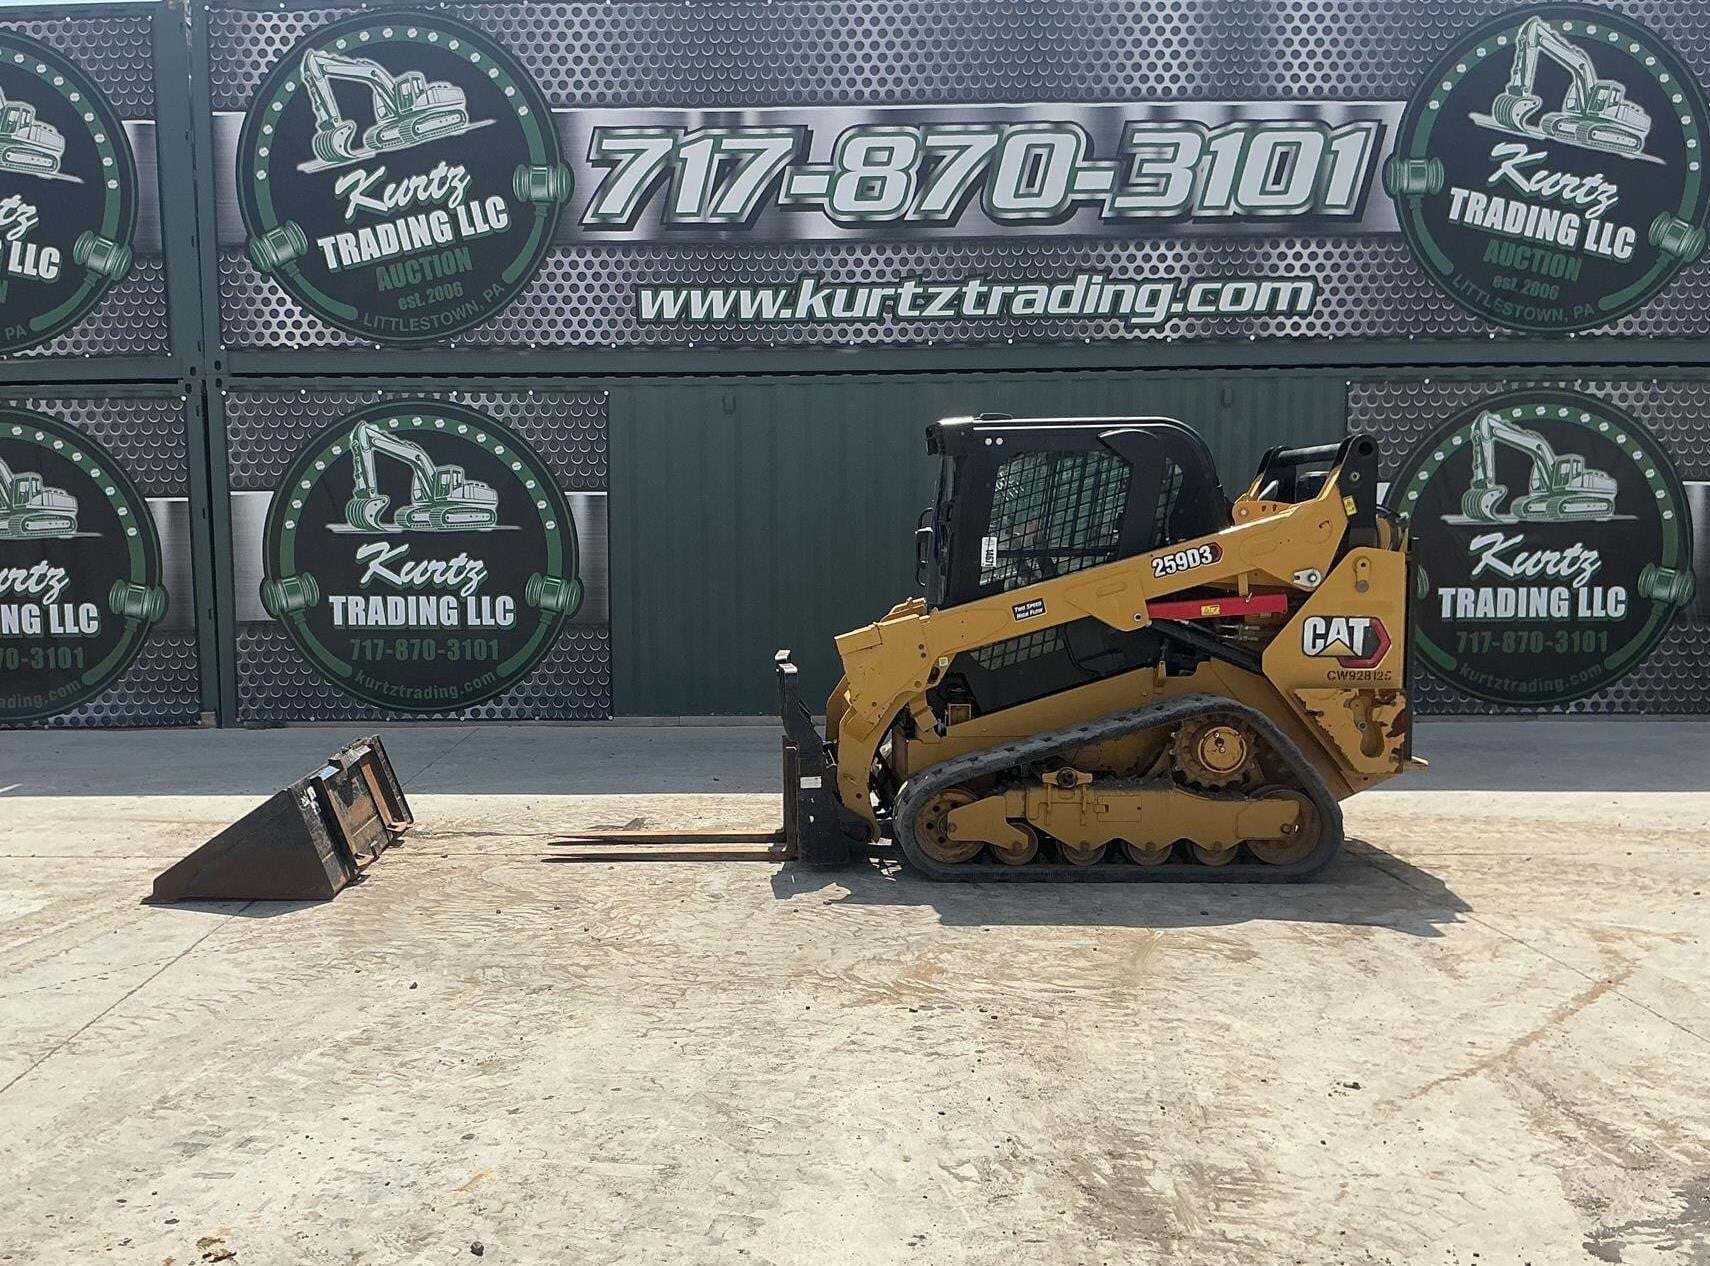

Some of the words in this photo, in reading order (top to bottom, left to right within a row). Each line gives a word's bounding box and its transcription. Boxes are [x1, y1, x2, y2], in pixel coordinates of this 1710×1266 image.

[334, 160, 472, 220] Kurtz
[584, 121, 1386, 226] 717-870-3101
[1487, 141, 1620, 219] Kurtz
[316, 209, 454, 270] TRADING
[456, 195, 510, 237] LLC
[1448, 186, 1583, 250] TRADING
[1583, 218, 1637, 261] LLC
[7, 240, 61, 280] LLC
[375, 246, 473, 292] AUCTION
[1482, 240, 1584, 282] AUCTION
[398, 293, 425, 311] est.
[426, 281, 464, 303] 2006
[482, 283, 505, 304] PA
[638, 273, 1316, 325] www.kurtztrading.com
[1572, 302, 1596, 320] PA
[4, 324, 28, 341] PA
[355, 541, 488, 598] Kurtz
[1151, 545, 1213, 578] 259D3
[1468, 531, 1602, 588] Kurtz
[49, 602, 99, 635] LLC
[328, 594, 459, 627] TRADING
[466, 594, 516, 627] LLC
[1438, 586, 1570, 619] TRADING
[1576, 585, 1627, 619] LLC
[349, 638, 500, 662] 717-870-3101
[1303, 616, 1370, 657] CAT
[1455, 630, 1609, 654] 717-870-3101
[354, 669, 497, 700] kurtztrading.com
[1457, 660, 1604, 694] kurtztrading.com
